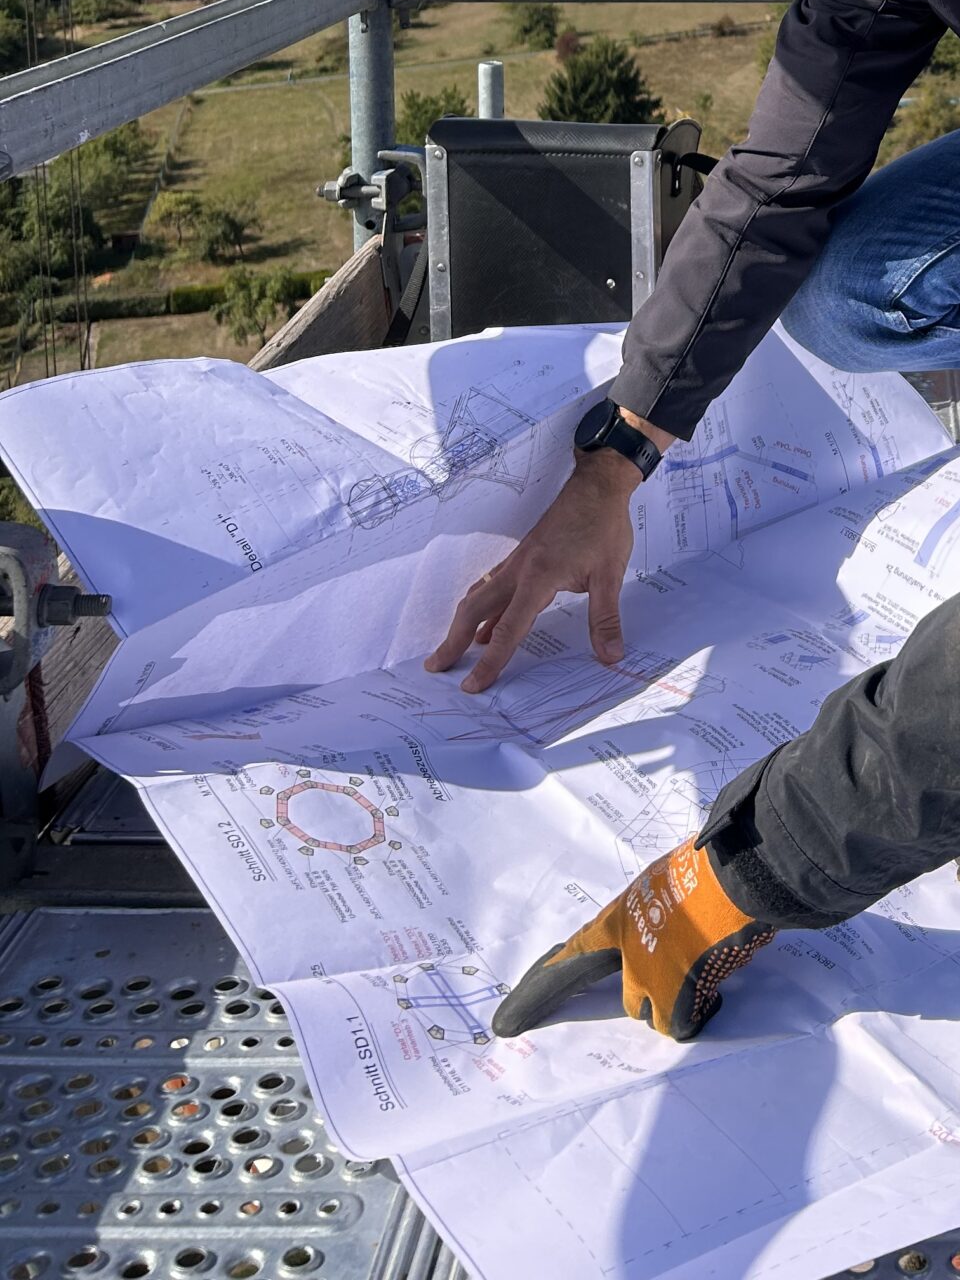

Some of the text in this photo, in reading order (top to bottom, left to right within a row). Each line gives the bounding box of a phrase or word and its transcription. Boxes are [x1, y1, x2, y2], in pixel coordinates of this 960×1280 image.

[217, 510, 262, 572] Detail "D1"
[398, 730, 448, 805] Abhebezustand
[217, 818, 266, 884] Schnitt SD1.2
[563, 881, 580, 897] 1/25
[345, 1012, 394, 1112] Schnitt SD1.1
